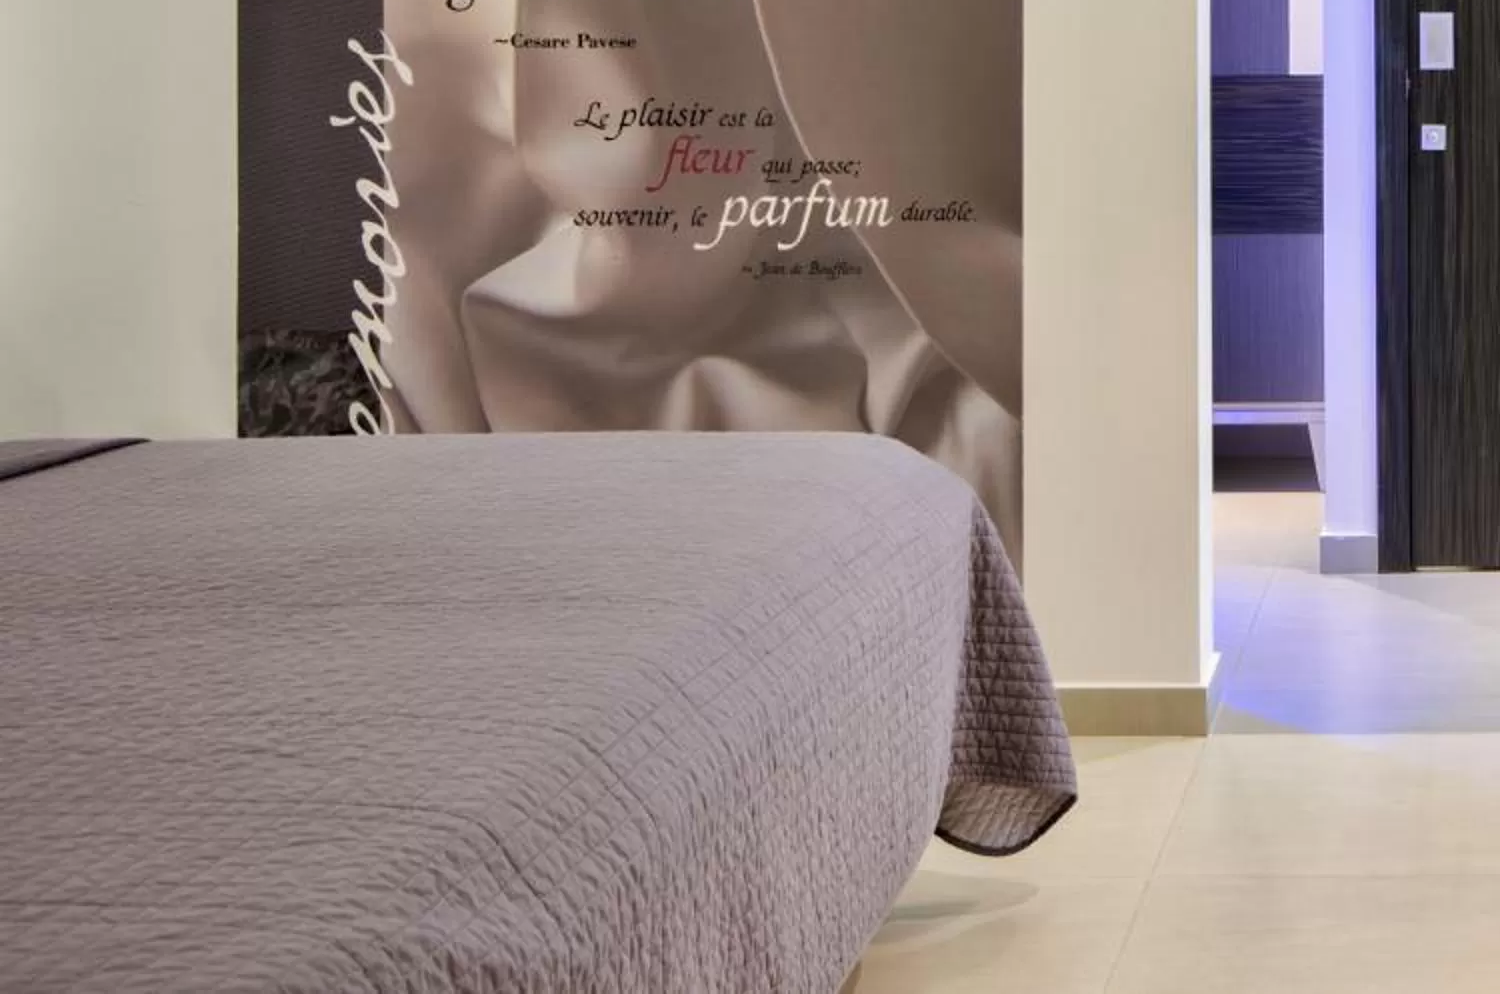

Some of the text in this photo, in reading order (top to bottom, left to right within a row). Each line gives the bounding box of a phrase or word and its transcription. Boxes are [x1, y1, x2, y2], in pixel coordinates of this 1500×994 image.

[576, 33, 638, 50] Pavese
[573, 97, 775, 141] Le plaisir est la
[645, 135, 864, 193] fleur qui passe;
[329, 29, 414, 437] emories
[572, 207, 681, 235] souvenir,
[690, 205, 709, 228] le
[693, 178, 894, 251] parfum
